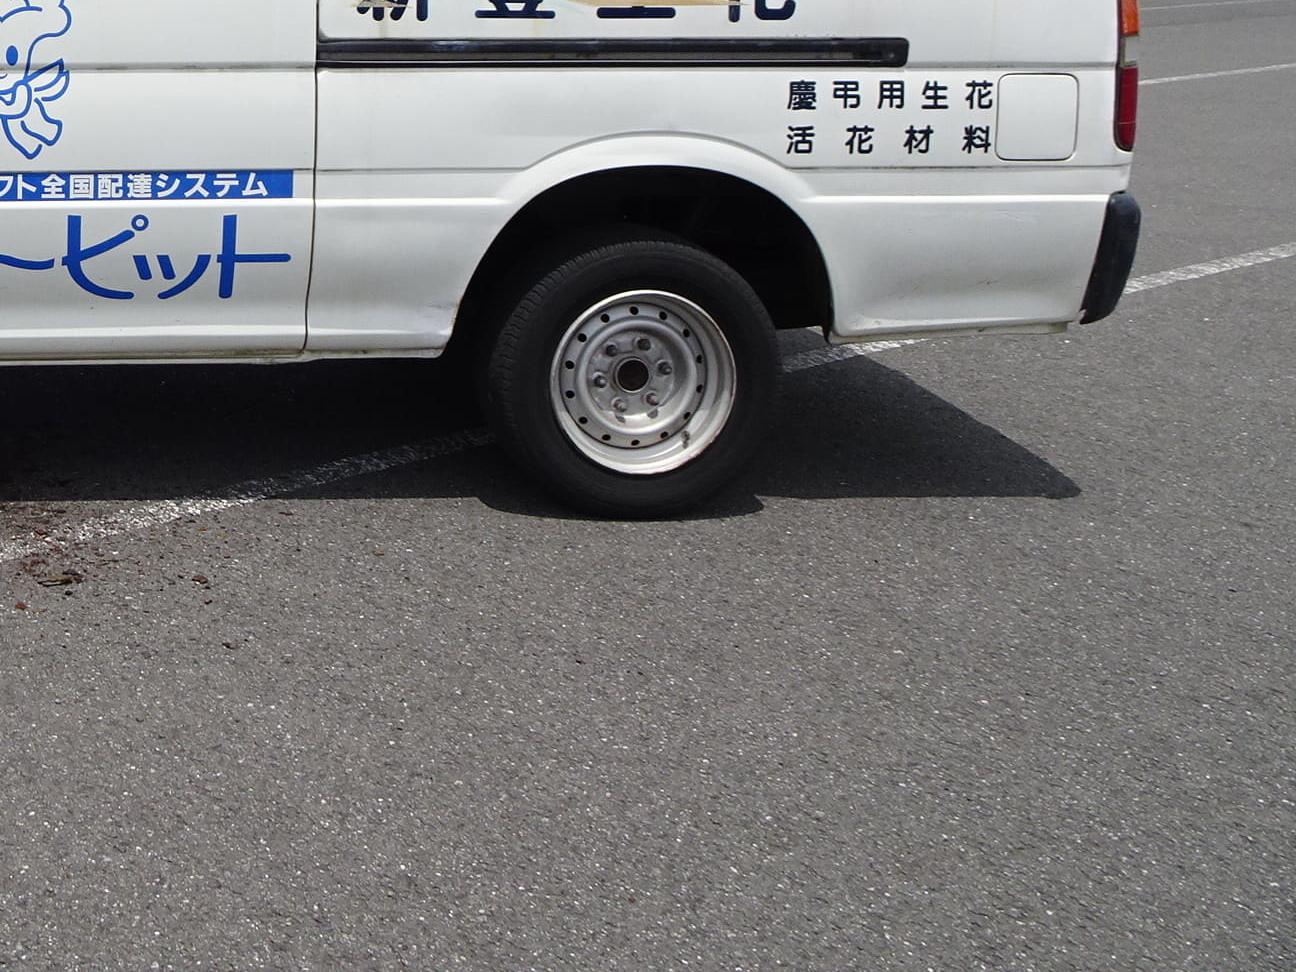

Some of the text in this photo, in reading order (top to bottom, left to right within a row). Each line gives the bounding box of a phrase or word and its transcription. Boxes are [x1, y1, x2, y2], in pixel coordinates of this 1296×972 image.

[787, 79, 994, 111] 慶弔用生花
[786, 124, 992, 155] 活花材料
